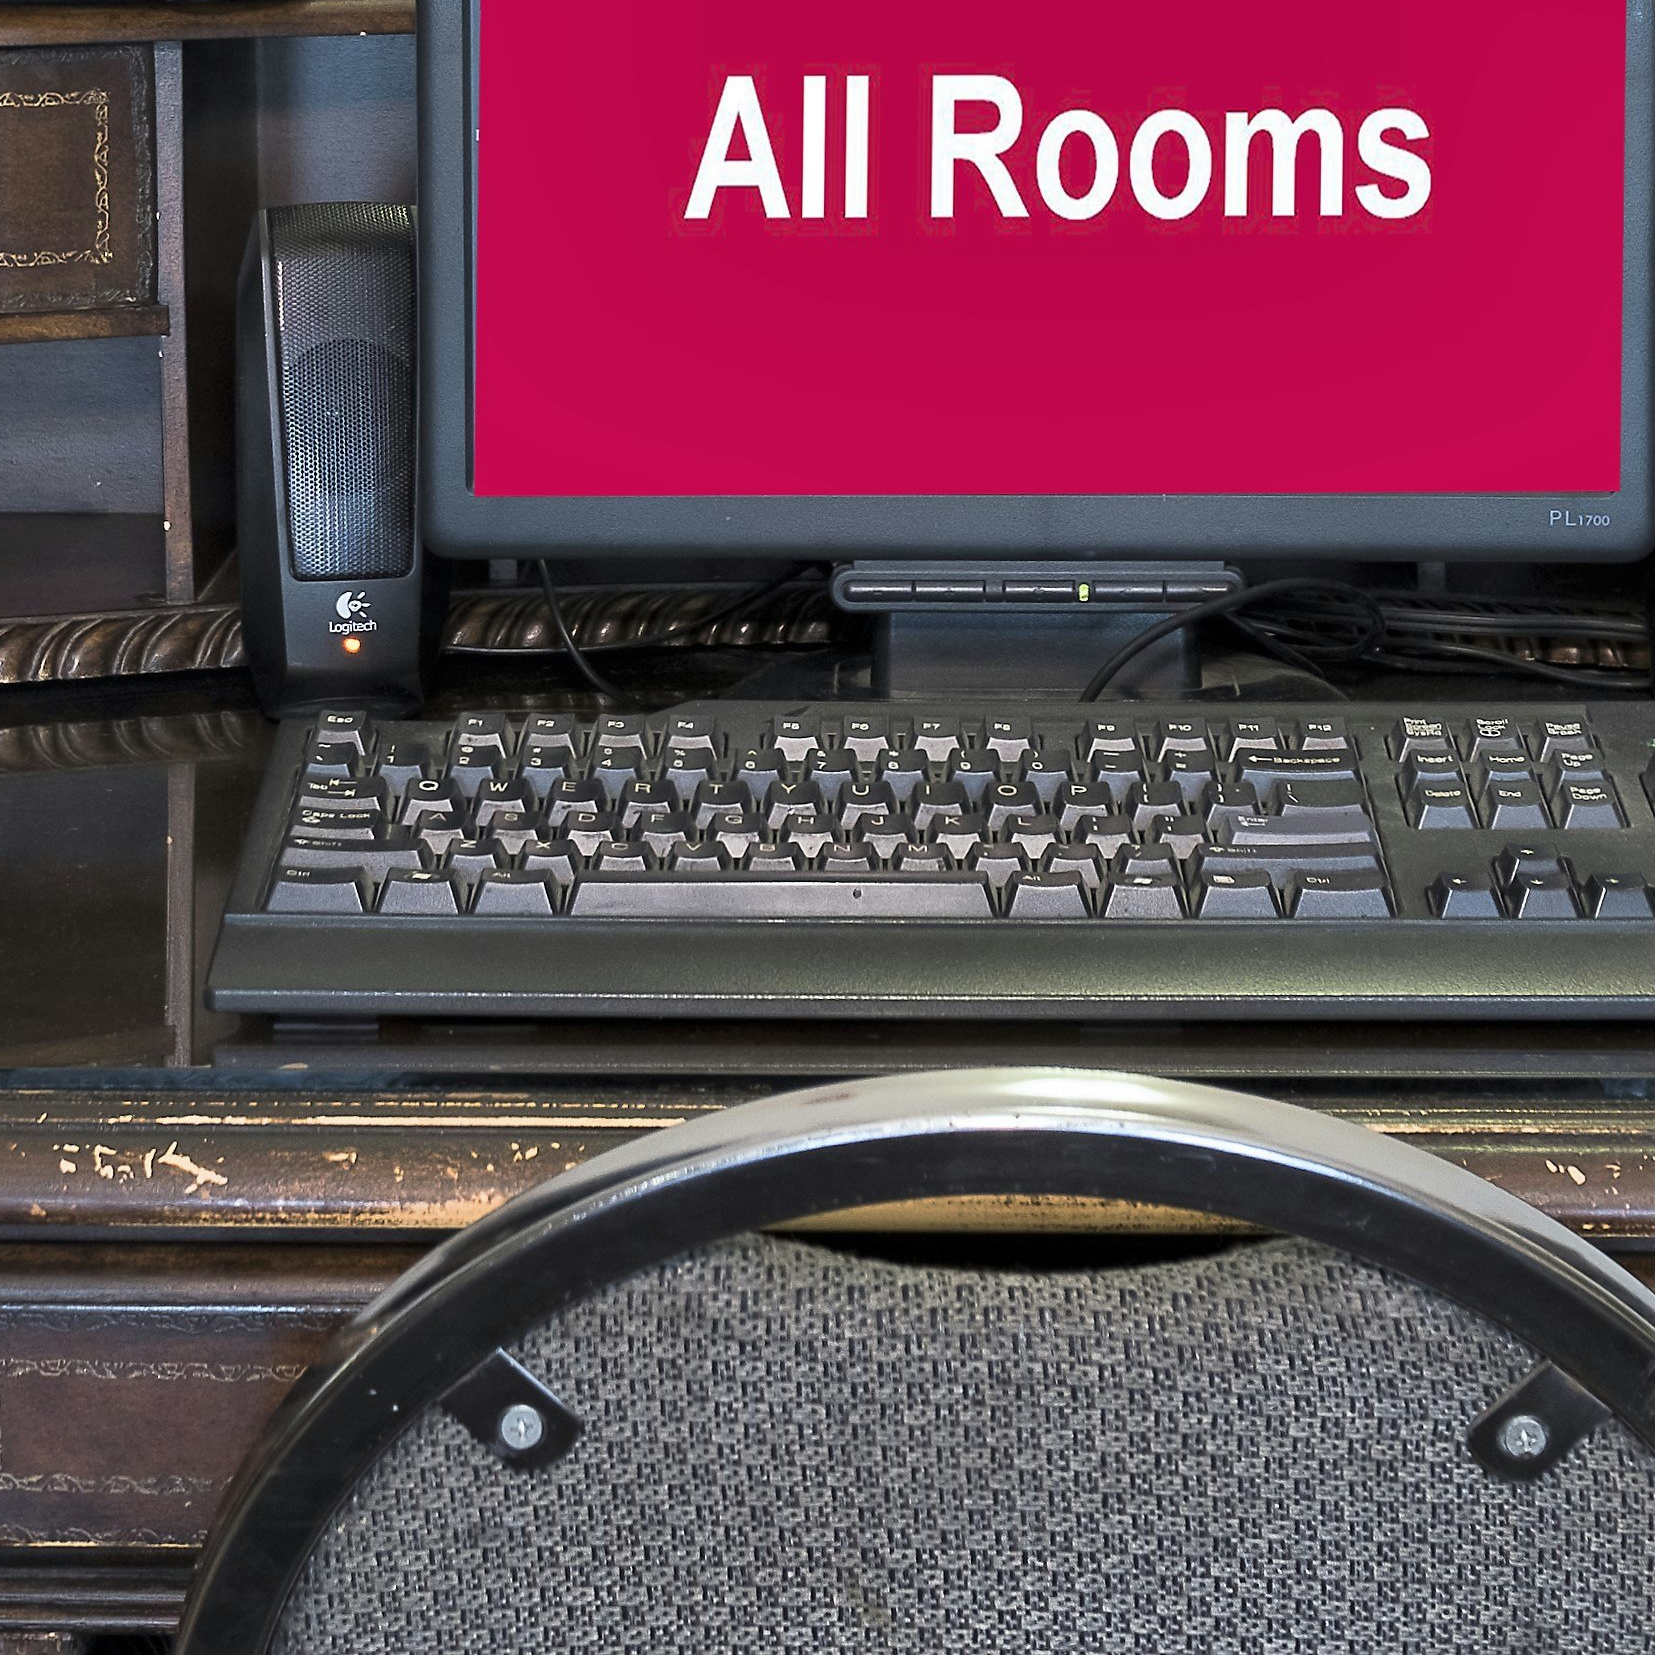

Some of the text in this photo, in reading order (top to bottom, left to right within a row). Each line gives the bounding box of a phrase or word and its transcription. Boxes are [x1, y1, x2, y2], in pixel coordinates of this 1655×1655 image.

[684, 74, 1432, 220] All Rooms
[1549, 510, 1611, 526] PL1700
[328, 619, 377, 635] Logitech
[468, 718, 483, 727] F1
[537, 719, 555, 727] F2
[677, 721, 694, 729] F4
[923, 722, 941, 731] F7
[1168, 724, 1192, 732] F10
[1238, 724, 1260, 732] F11
[1273, 756, 1341, 765] Backspace
[1417, 755, 1454, 763] Insert
[418, 780, 439, 791] Q
[489, 781, 509, 792] W
[562, 781, 576, 792] E
[635, 783, 651, 793] R
[709, 783, 724, 794] T
[781, 783, 797, 794] Y
[852, 784, 870, 795] U
[1071, 785, 1087, 796] P
[1498, 789, 1522, 798] End
[578, 813, 596, 822] D
[650, 813, 665, 823] F
[797, 816, 814, 825] H
[871, 816, 884, 825] J
[945, 816, 961, 826] K
